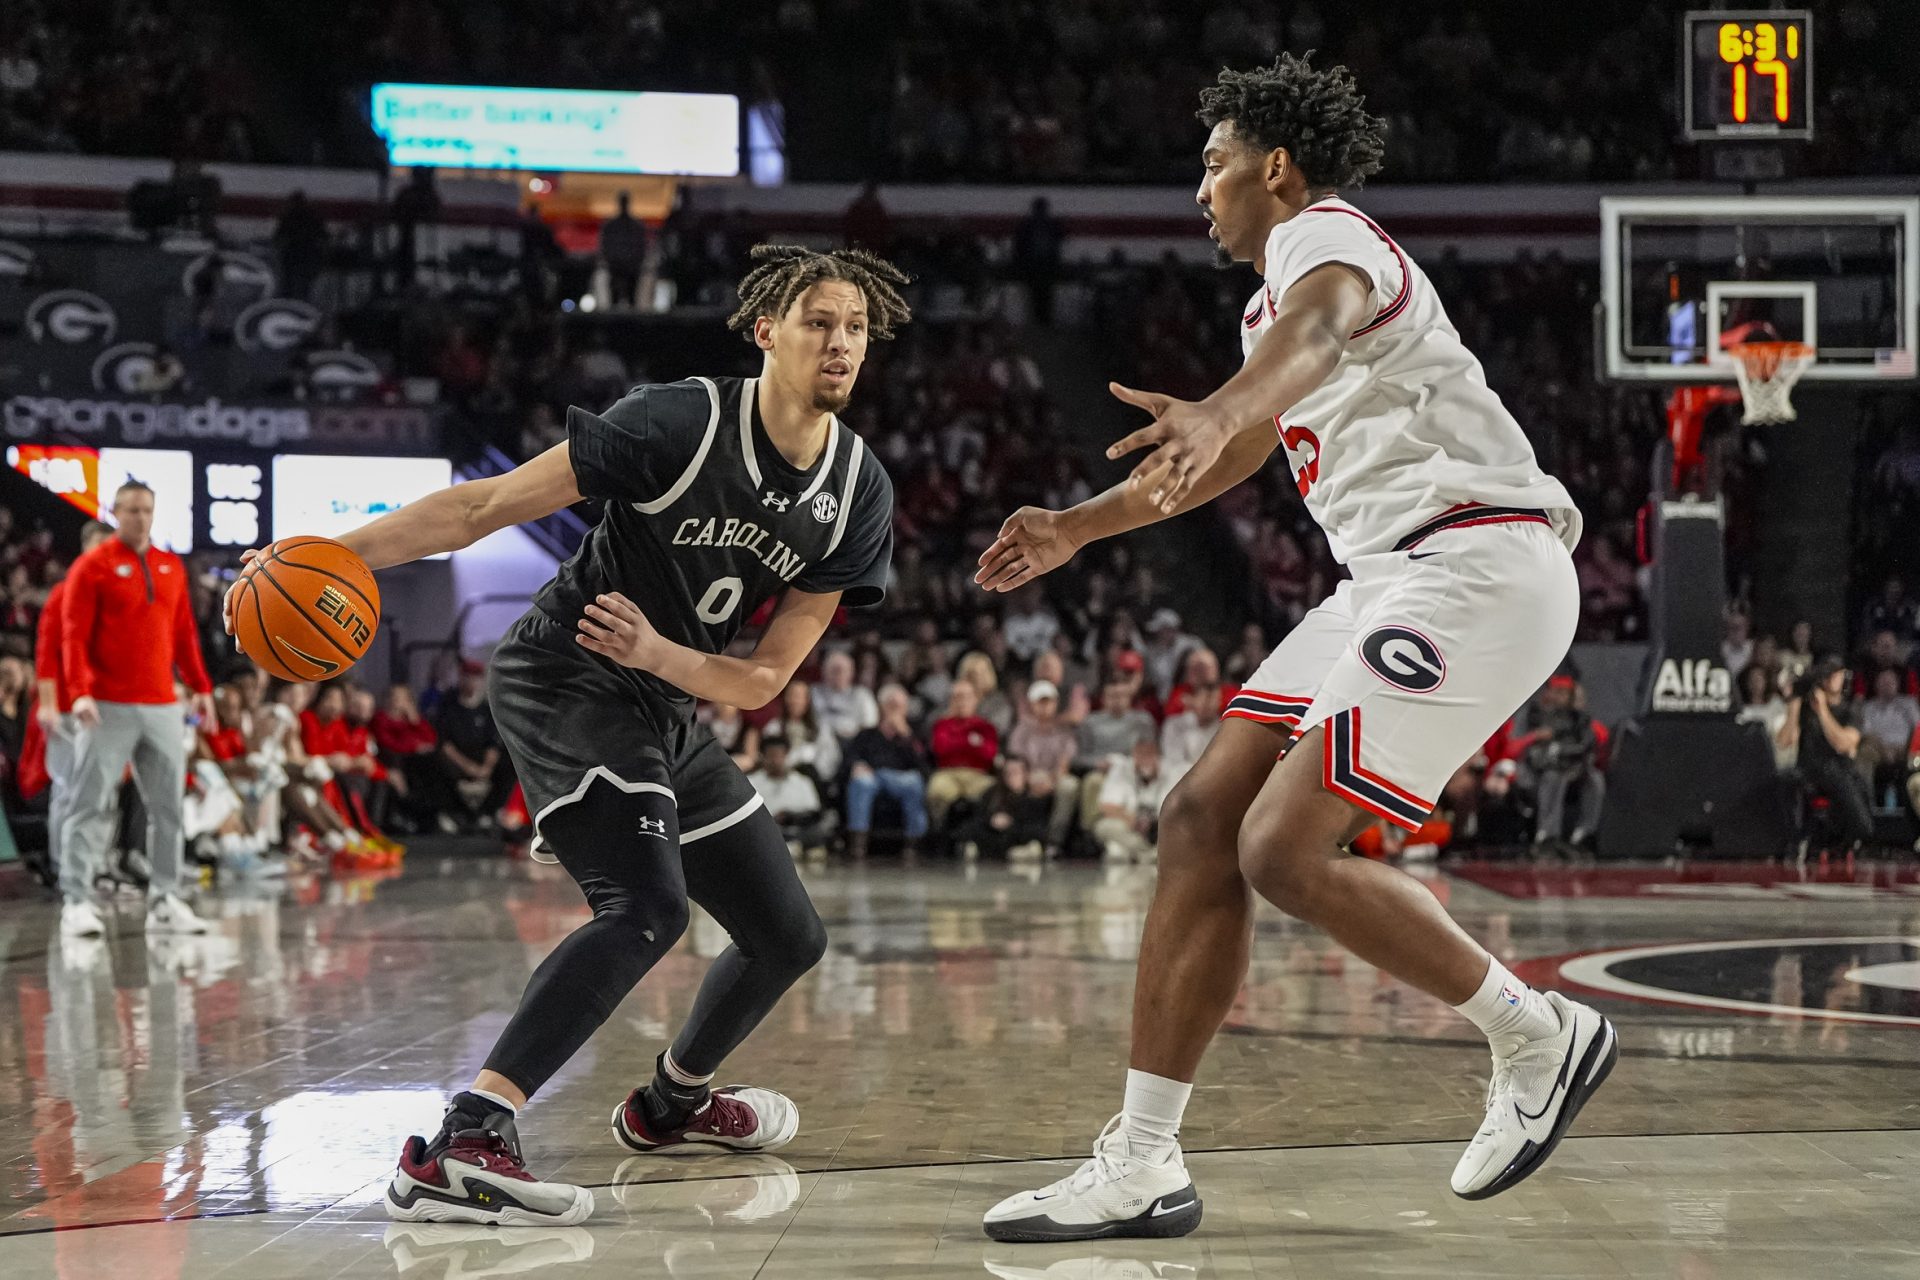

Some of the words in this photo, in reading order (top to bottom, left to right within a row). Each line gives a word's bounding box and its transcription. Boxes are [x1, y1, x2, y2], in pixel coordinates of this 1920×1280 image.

[1720, 23, 1798, 62] 6:31
[1733, 60, 1788, 122] 17
[813, 495, 837, 521] SEC
[314, 590, 371, 649] ELITE
[695, 576, 744, 625] 0
[1358, 624, 1446, 693] G
[1653, 658, 1731, 698] Alfa
